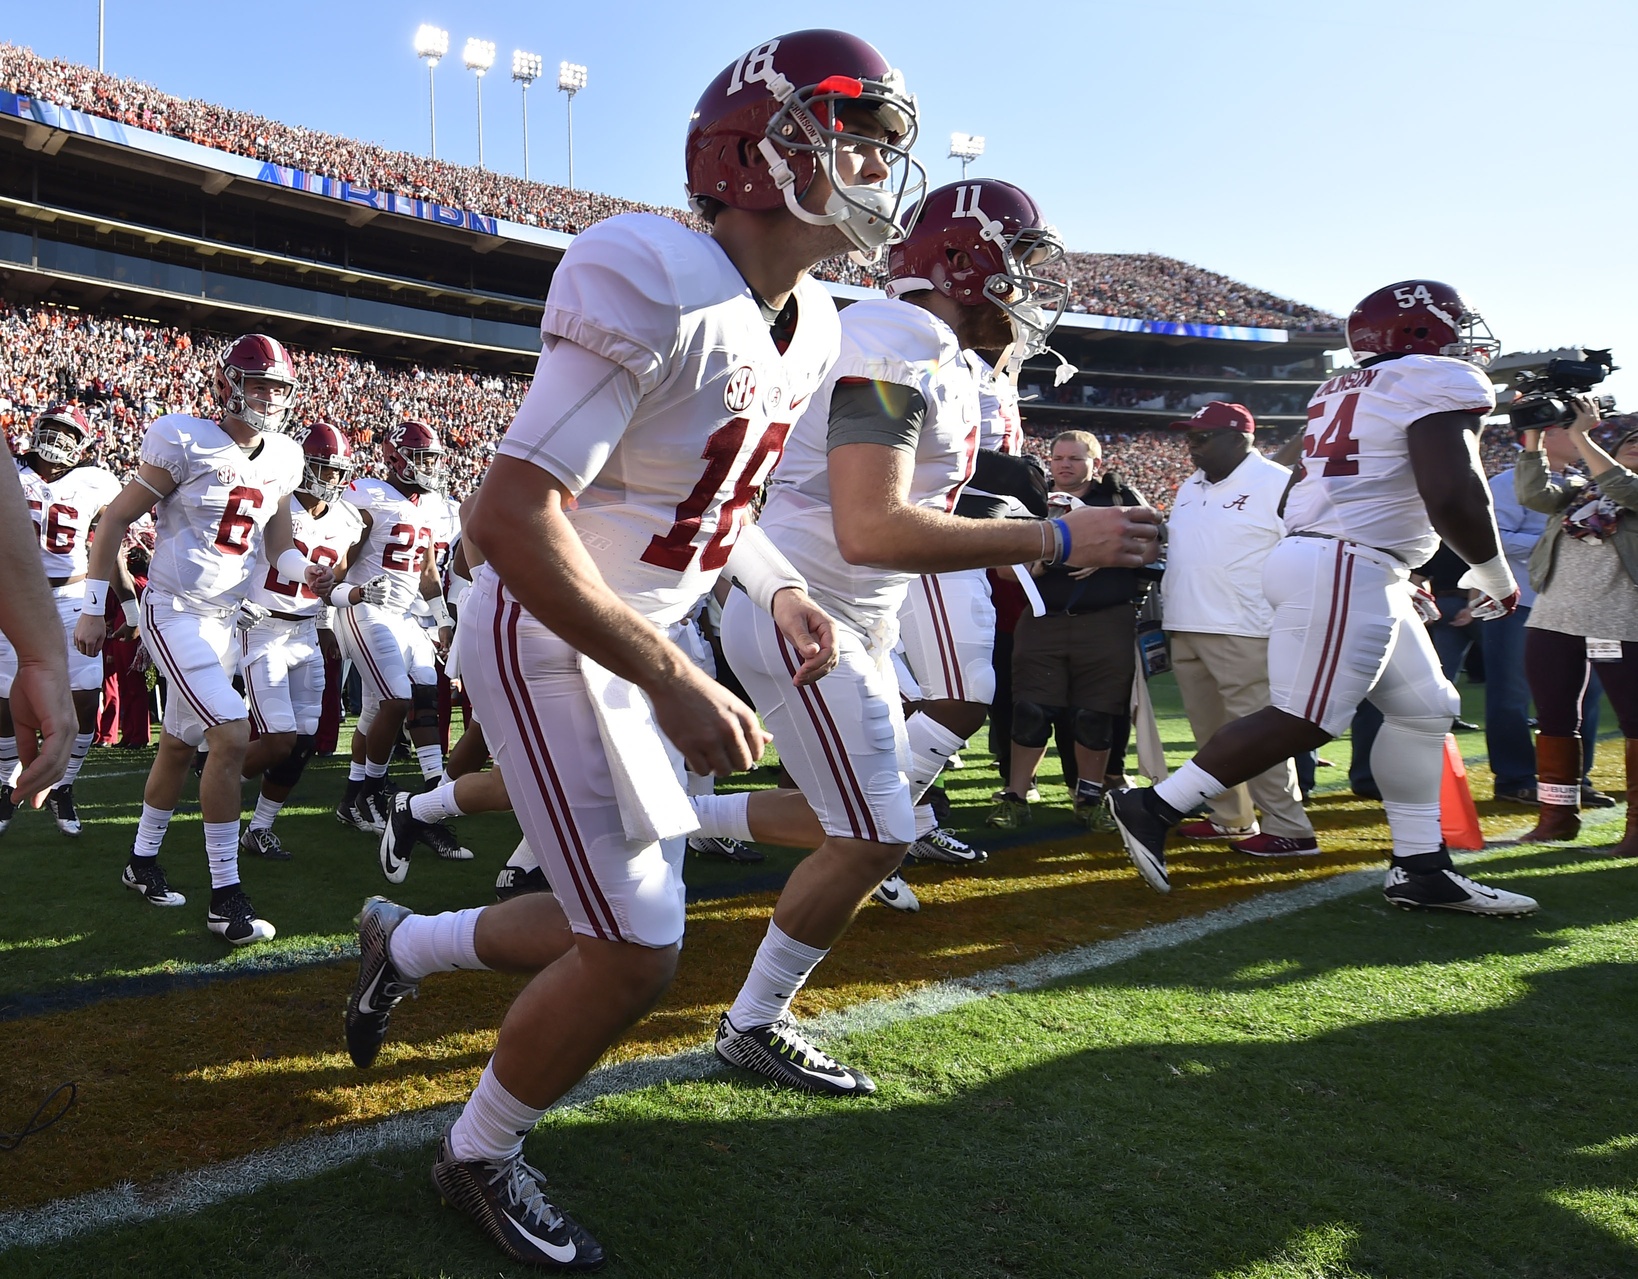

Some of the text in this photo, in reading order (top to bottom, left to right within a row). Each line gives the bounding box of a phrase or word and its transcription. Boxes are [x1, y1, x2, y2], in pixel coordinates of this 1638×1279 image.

[727, 39, 781, 97] 18
[814, 137, 829, 159] TIE
[951, 184, 982, 218] 11
[1393, 284, 1434, 309] 54
[389, 425, 407, 448] 22
[1298, 392, 1360, 477] 54
[1222, 494, 1251, 511] A
[214, 485, 264, 556] 6
[382, 522, 432, 573] 22
[1538, 784, 1580, 794] UBUR
